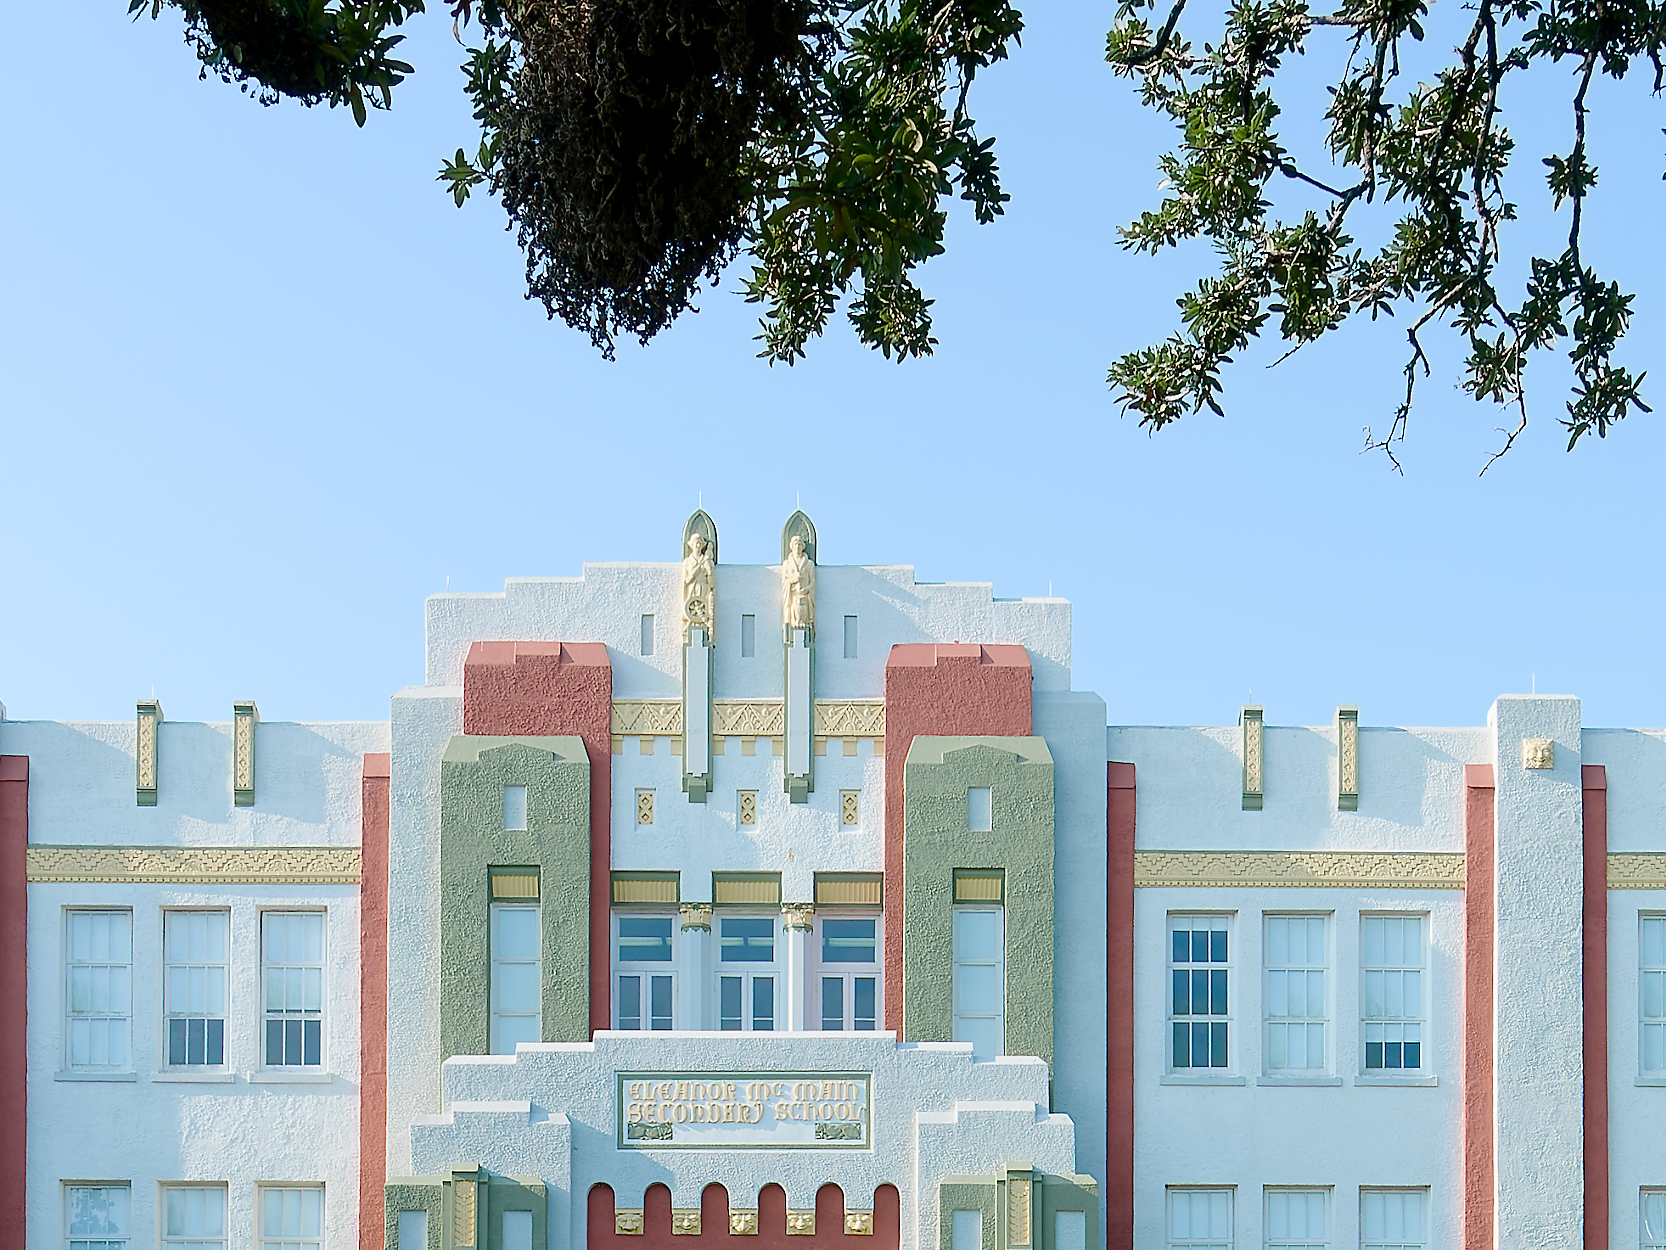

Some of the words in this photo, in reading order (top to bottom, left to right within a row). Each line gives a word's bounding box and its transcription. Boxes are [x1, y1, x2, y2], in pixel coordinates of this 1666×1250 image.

[628, 1080, 737, 1101] ELEANOR
[793, 1080, 859, 1101] MAIN
[774, 1101, 866, 1121] SCHOOL
